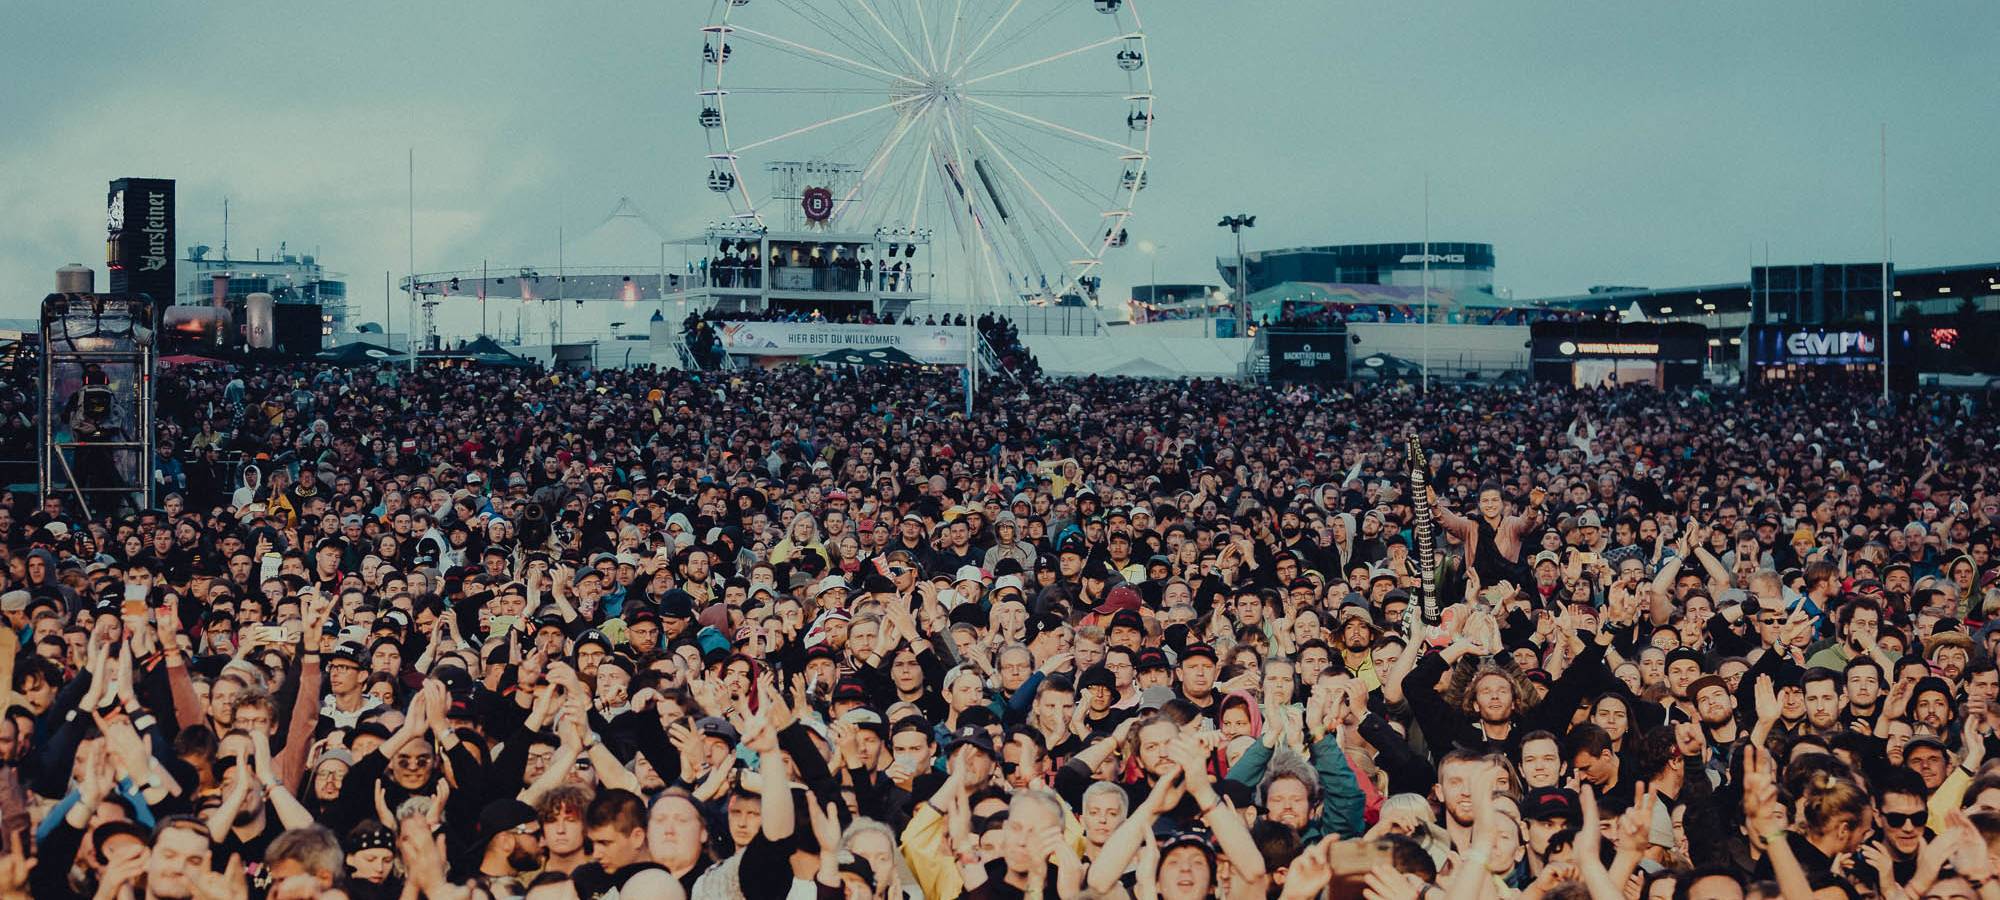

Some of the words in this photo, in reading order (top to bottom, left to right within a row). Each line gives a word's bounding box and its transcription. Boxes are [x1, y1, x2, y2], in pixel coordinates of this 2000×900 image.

[813, 198, 822, 210] B
[1421, 254, 1465, 263] AMG
[788, 334, 808, 343] HIER
[810, 334, 829, 344] BIST
[831, 334, 843, 344] DU
[844, 334, 901, 345] WILLKOMMEN
[1786, 332, 1858, 355] EMP
